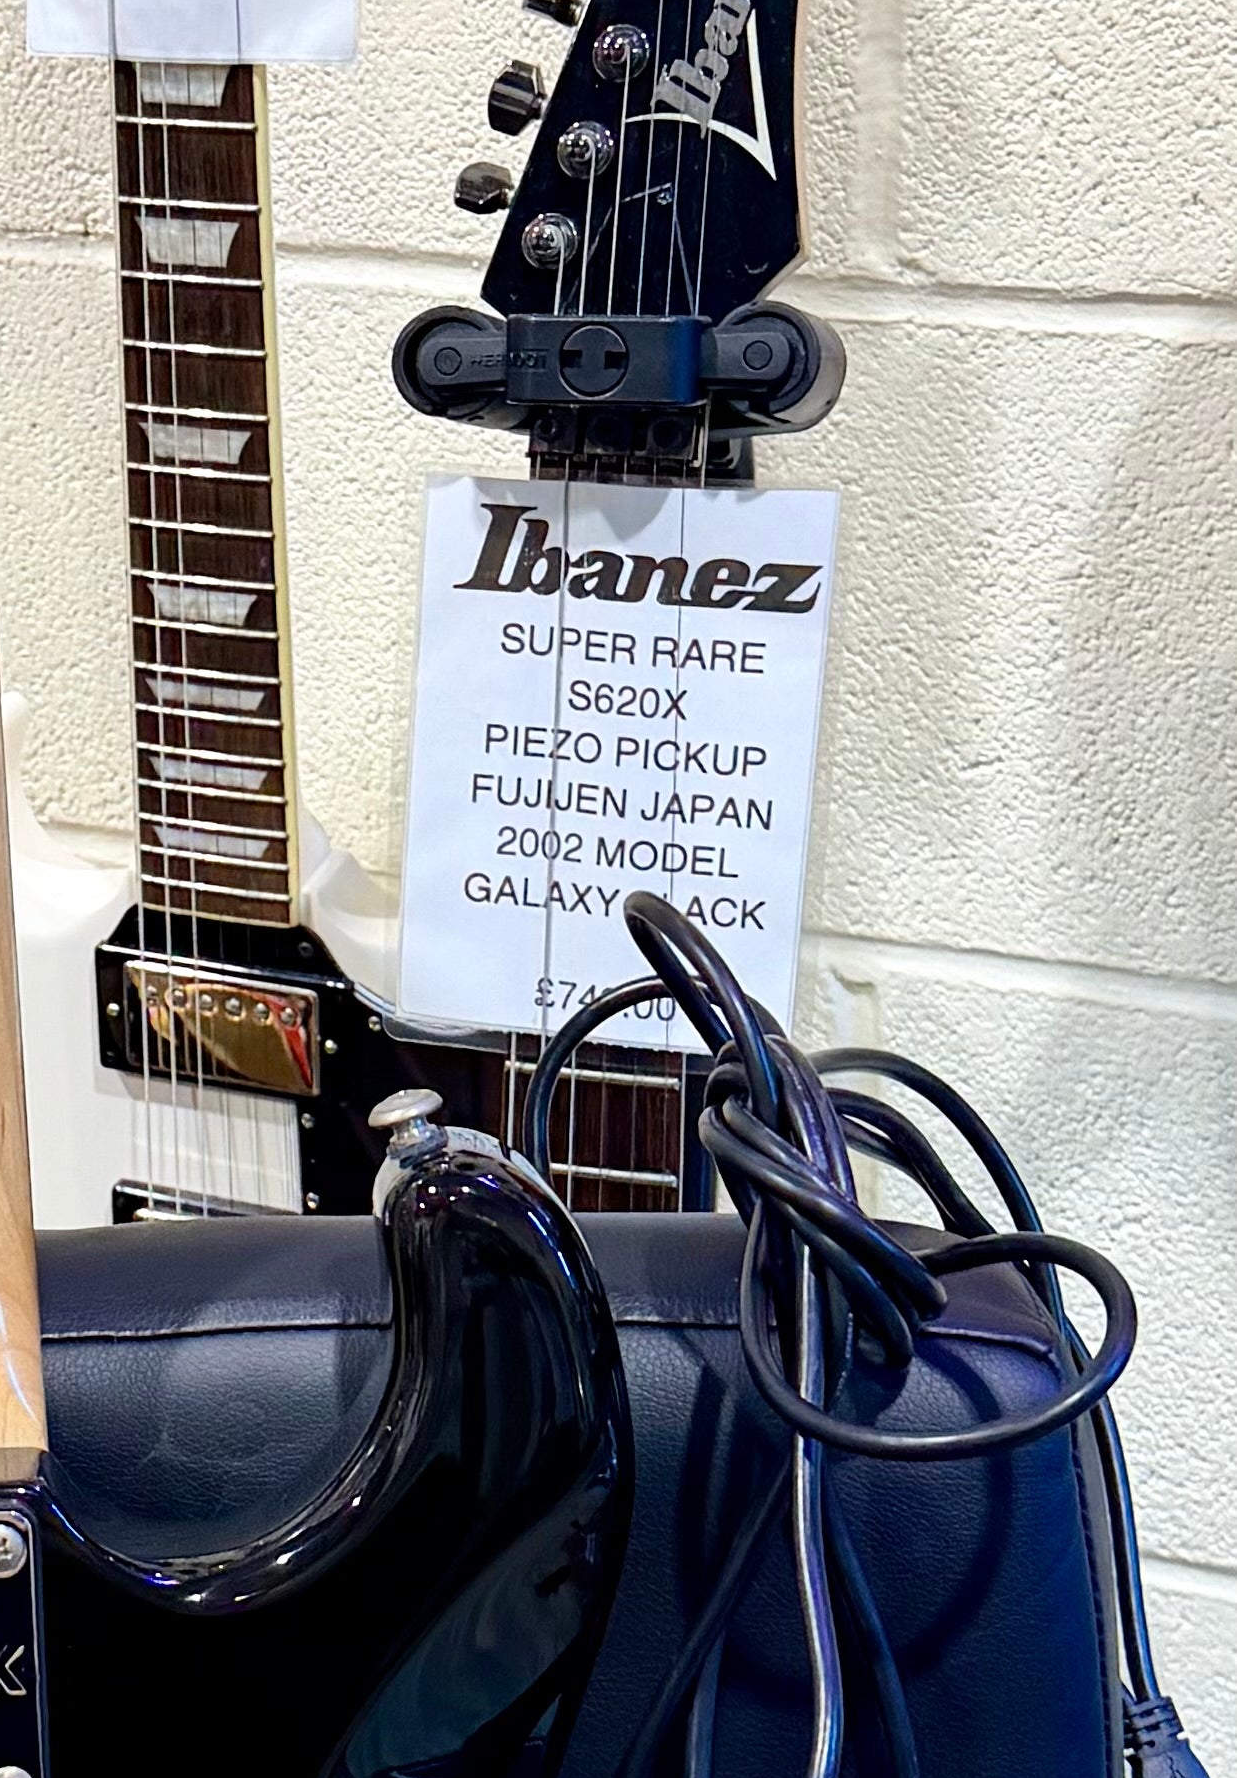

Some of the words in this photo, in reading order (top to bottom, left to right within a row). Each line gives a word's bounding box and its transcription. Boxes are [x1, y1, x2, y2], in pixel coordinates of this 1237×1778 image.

[453, 502, 823, 614] Ibanez
[500, 622, 636, 666] SUPER
[651, 635, 766, 675] RARE
[567, 680, 688, 721] S620X
[484, 723, 603, 765] PIEZO
[615, 735, 767, 778] PICKUP
[470, 774, 628, 821] FUJIJEN
[640, 790, 773, 831] JAPAN
[496, 826, 584, 863] 2002
[596, 836, 739, 879] MODEL
[463, 873, 620, 918] GALAXY
[663, 892, 767, 931] ACK
[535, 976, 676, 1022] £74.00
